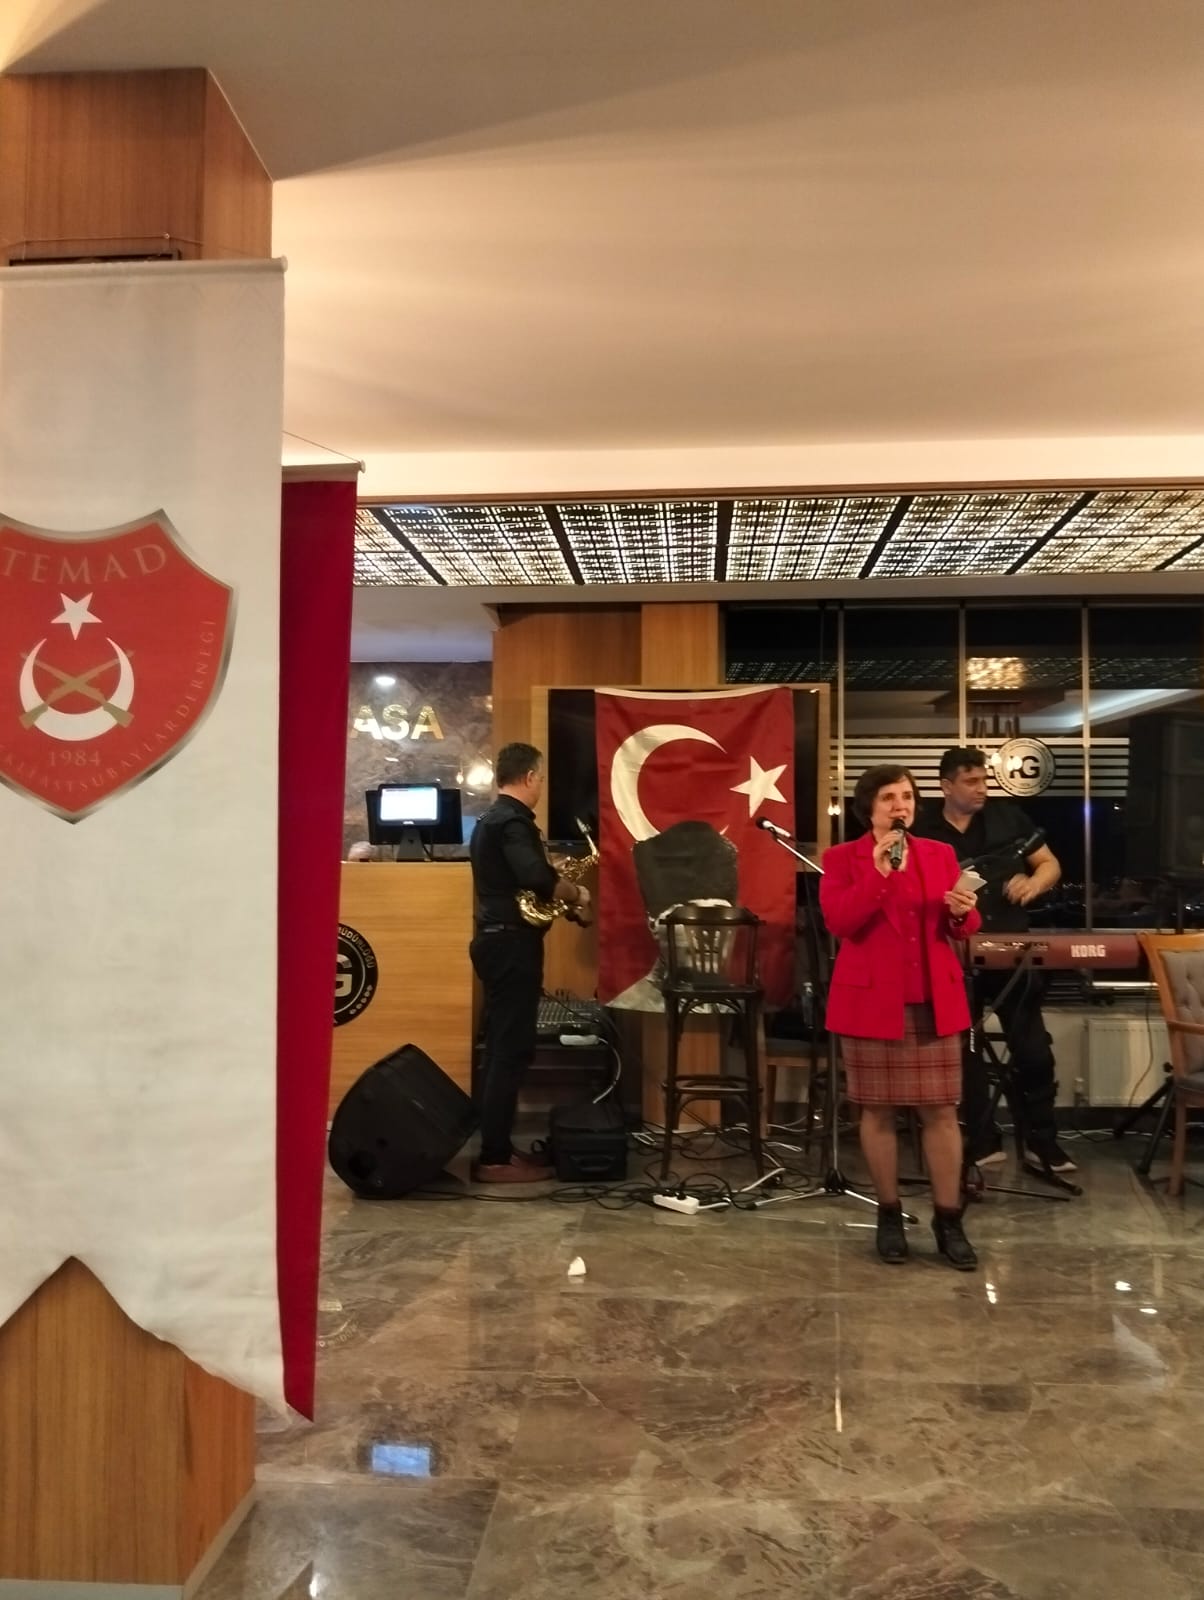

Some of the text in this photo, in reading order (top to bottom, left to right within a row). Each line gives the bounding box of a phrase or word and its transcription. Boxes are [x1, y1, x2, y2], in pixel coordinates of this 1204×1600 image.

[1, 543, 167, 585] TEMAD
[49, 750, 102, 768] 1984
[1070, 944, 1107, 958] KORG
